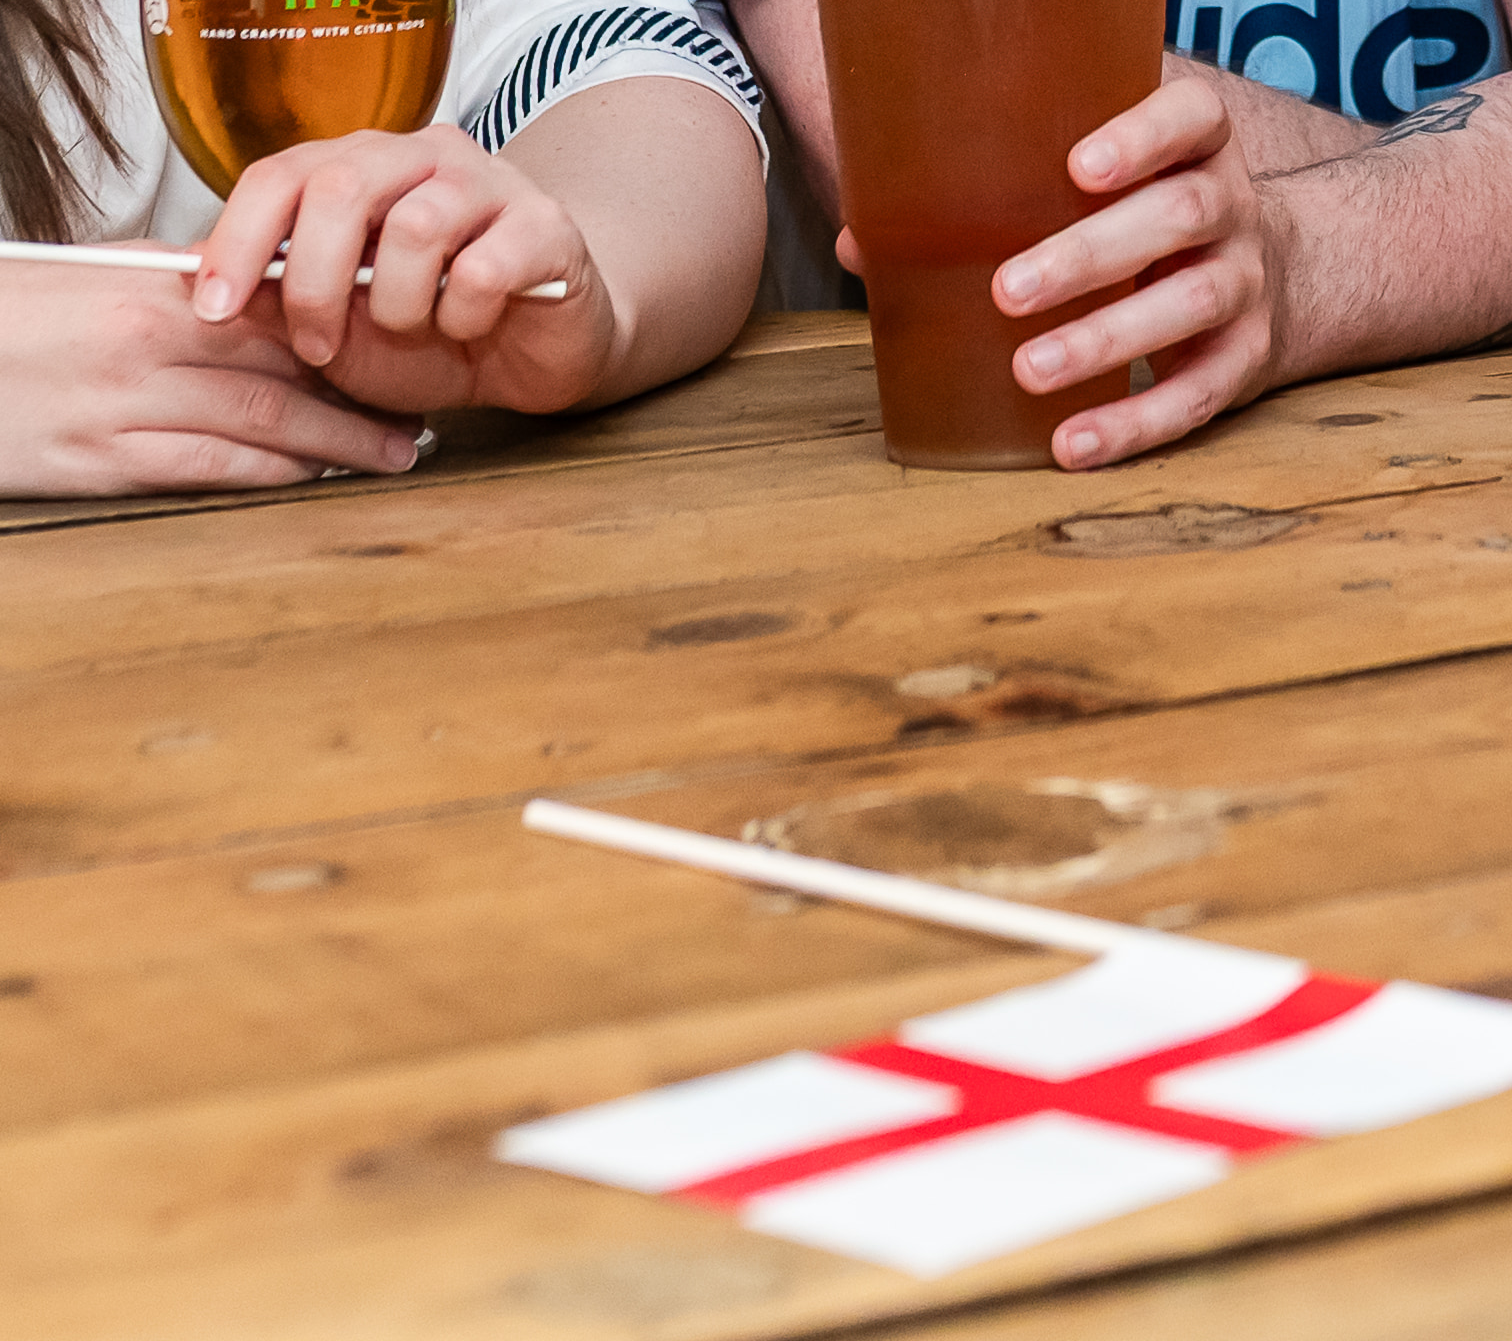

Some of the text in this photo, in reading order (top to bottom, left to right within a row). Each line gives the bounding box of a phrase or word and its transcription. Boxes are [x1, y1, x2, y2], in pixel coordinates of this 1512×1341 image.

[199, 28, 236, 40] HAND
[240, 27, 306, 40] CRAFTED
[312, 25, 350, 38] WITH
[353, 22, 393, 36] CITRA
